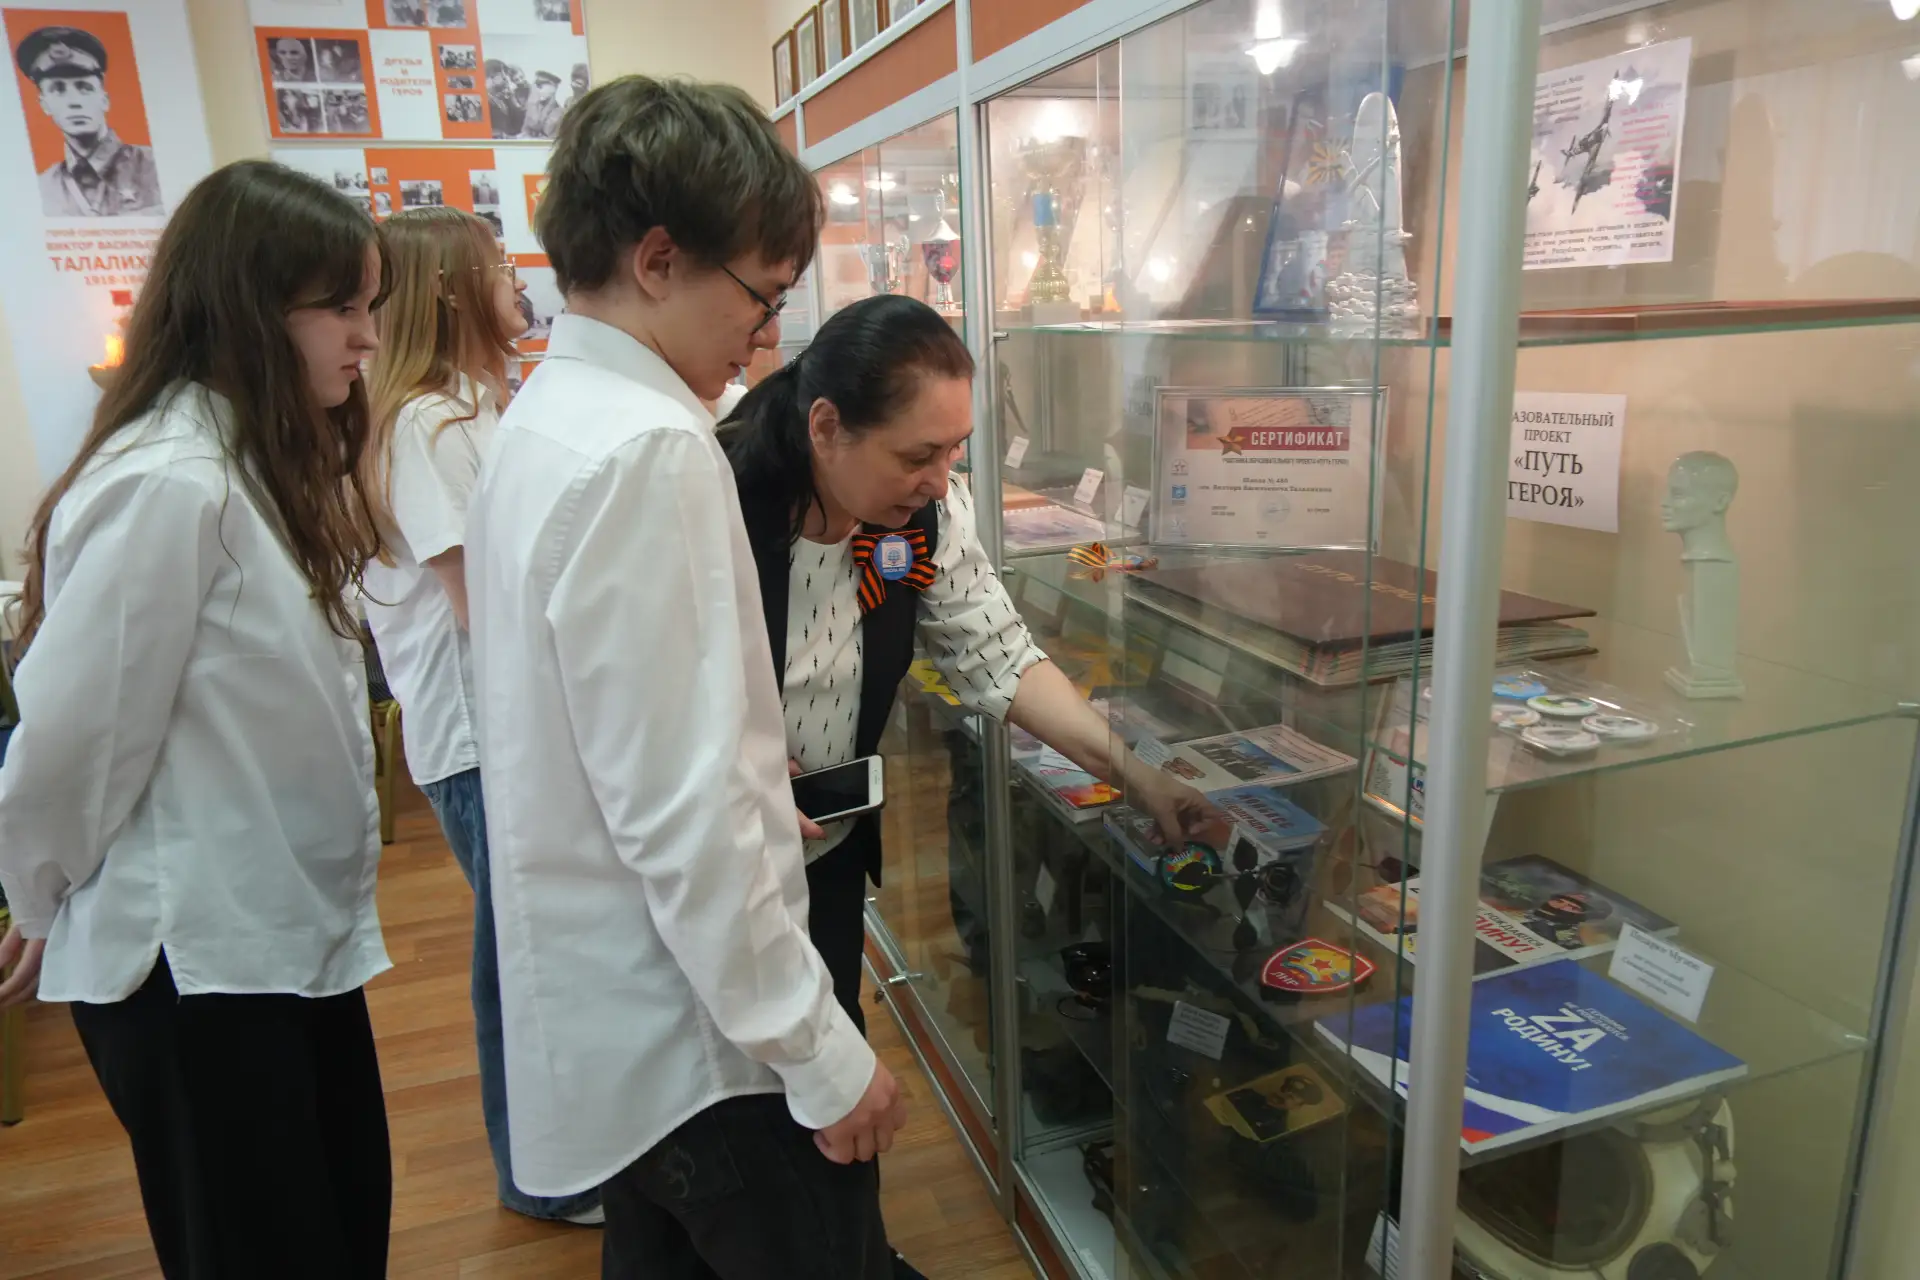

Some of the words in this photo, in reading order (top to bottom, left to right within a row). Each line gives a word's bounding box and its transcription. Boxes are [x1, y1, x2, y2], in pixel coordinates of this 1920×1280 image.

[1251, 431, 1344, 446] СЕРТИФИКАТ
[1523, 429, 1572, 443] ПРОЕКТ
[1514, 450, 1584, 478] «ПУТЬ
[1507, 481, 1585, 508] ГЕРОЯ»
[1490, 1007, 1593, 1072] РОДИНУ!
